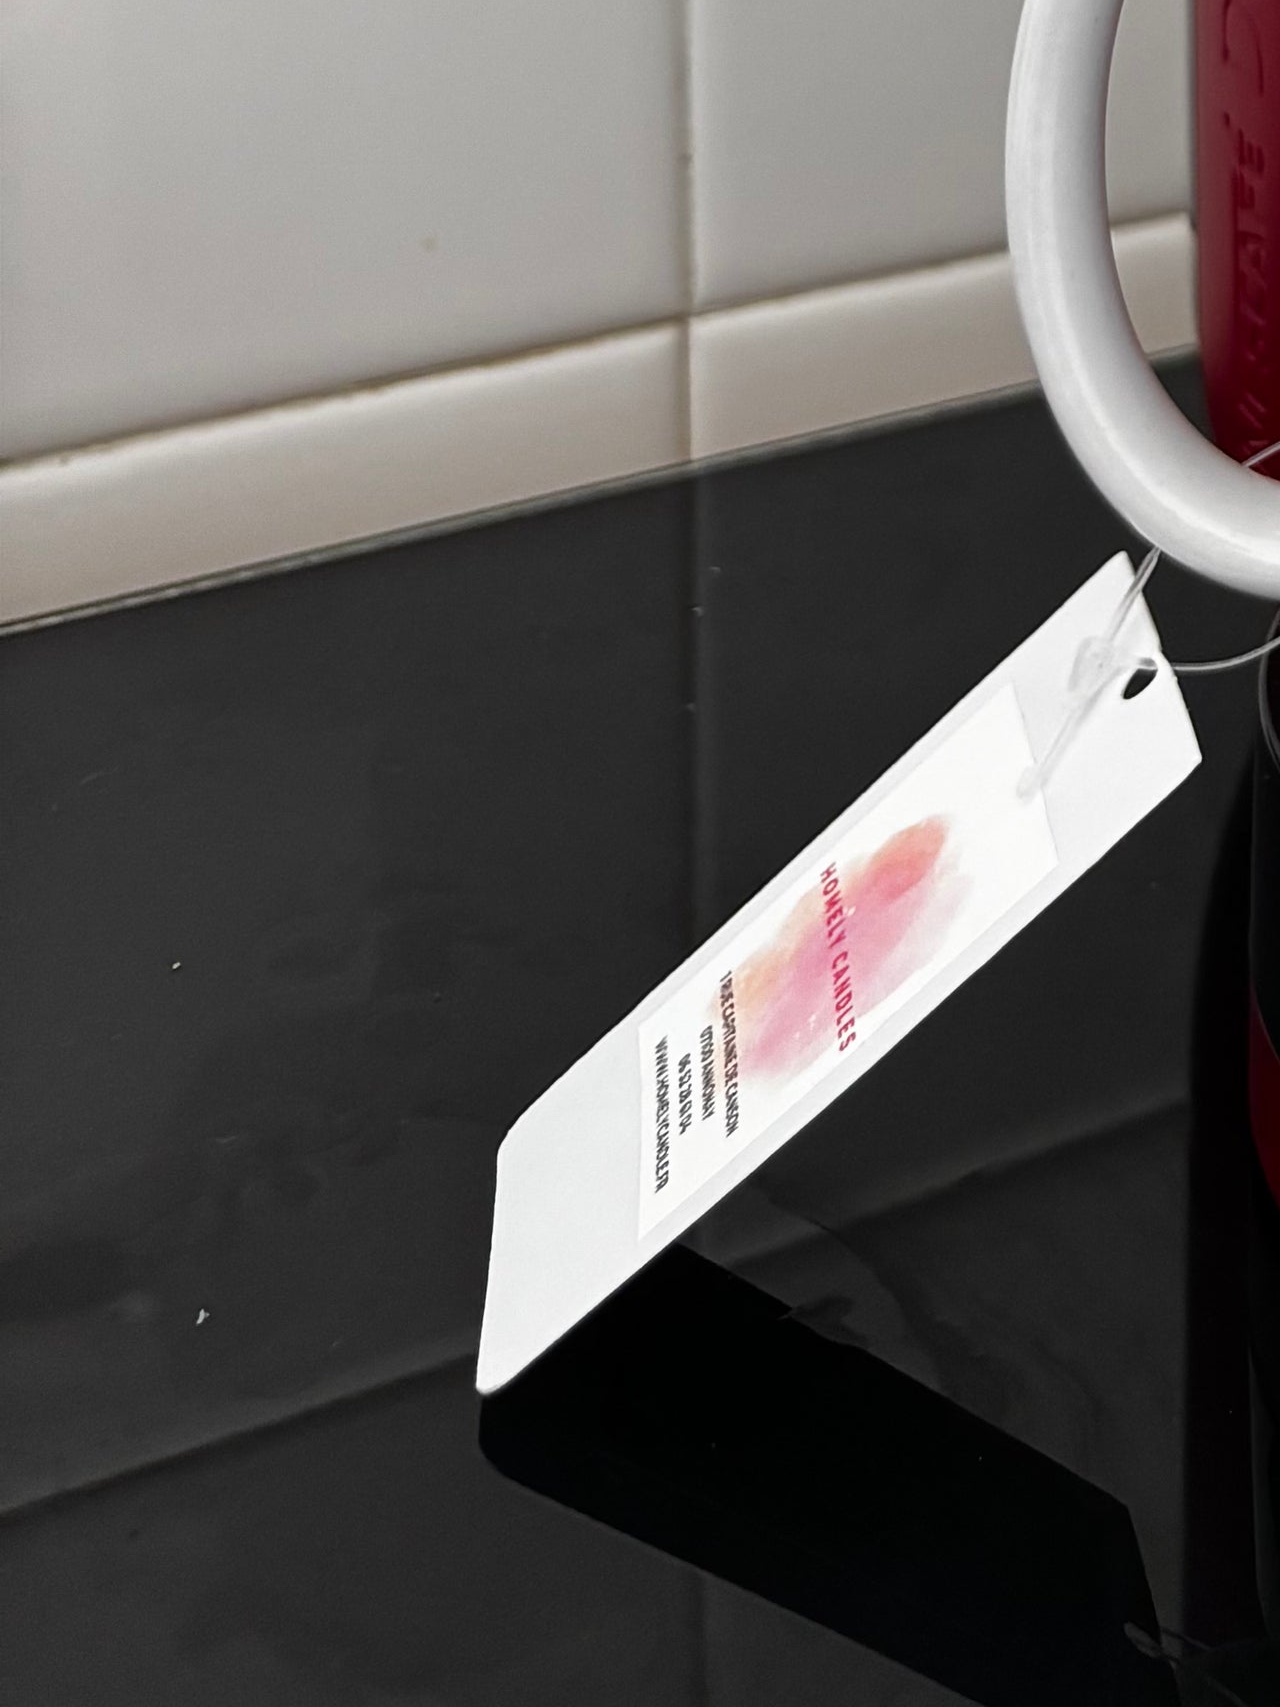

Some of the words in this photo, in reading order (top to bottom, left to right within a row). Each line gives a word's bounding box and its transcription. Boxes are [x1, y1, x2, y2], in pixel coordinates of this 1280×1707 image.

[820, 862, 847, 951] HOMELY
[831, 950, 857, 1052] CANDLES
[721, 1001, 736, 1069] CAPITAINE
[701, 1058, 715, 1122] ANNONAY
[724, 1063, 737, 1086] DE
[725, 1081, 739, 1137] CANSON
